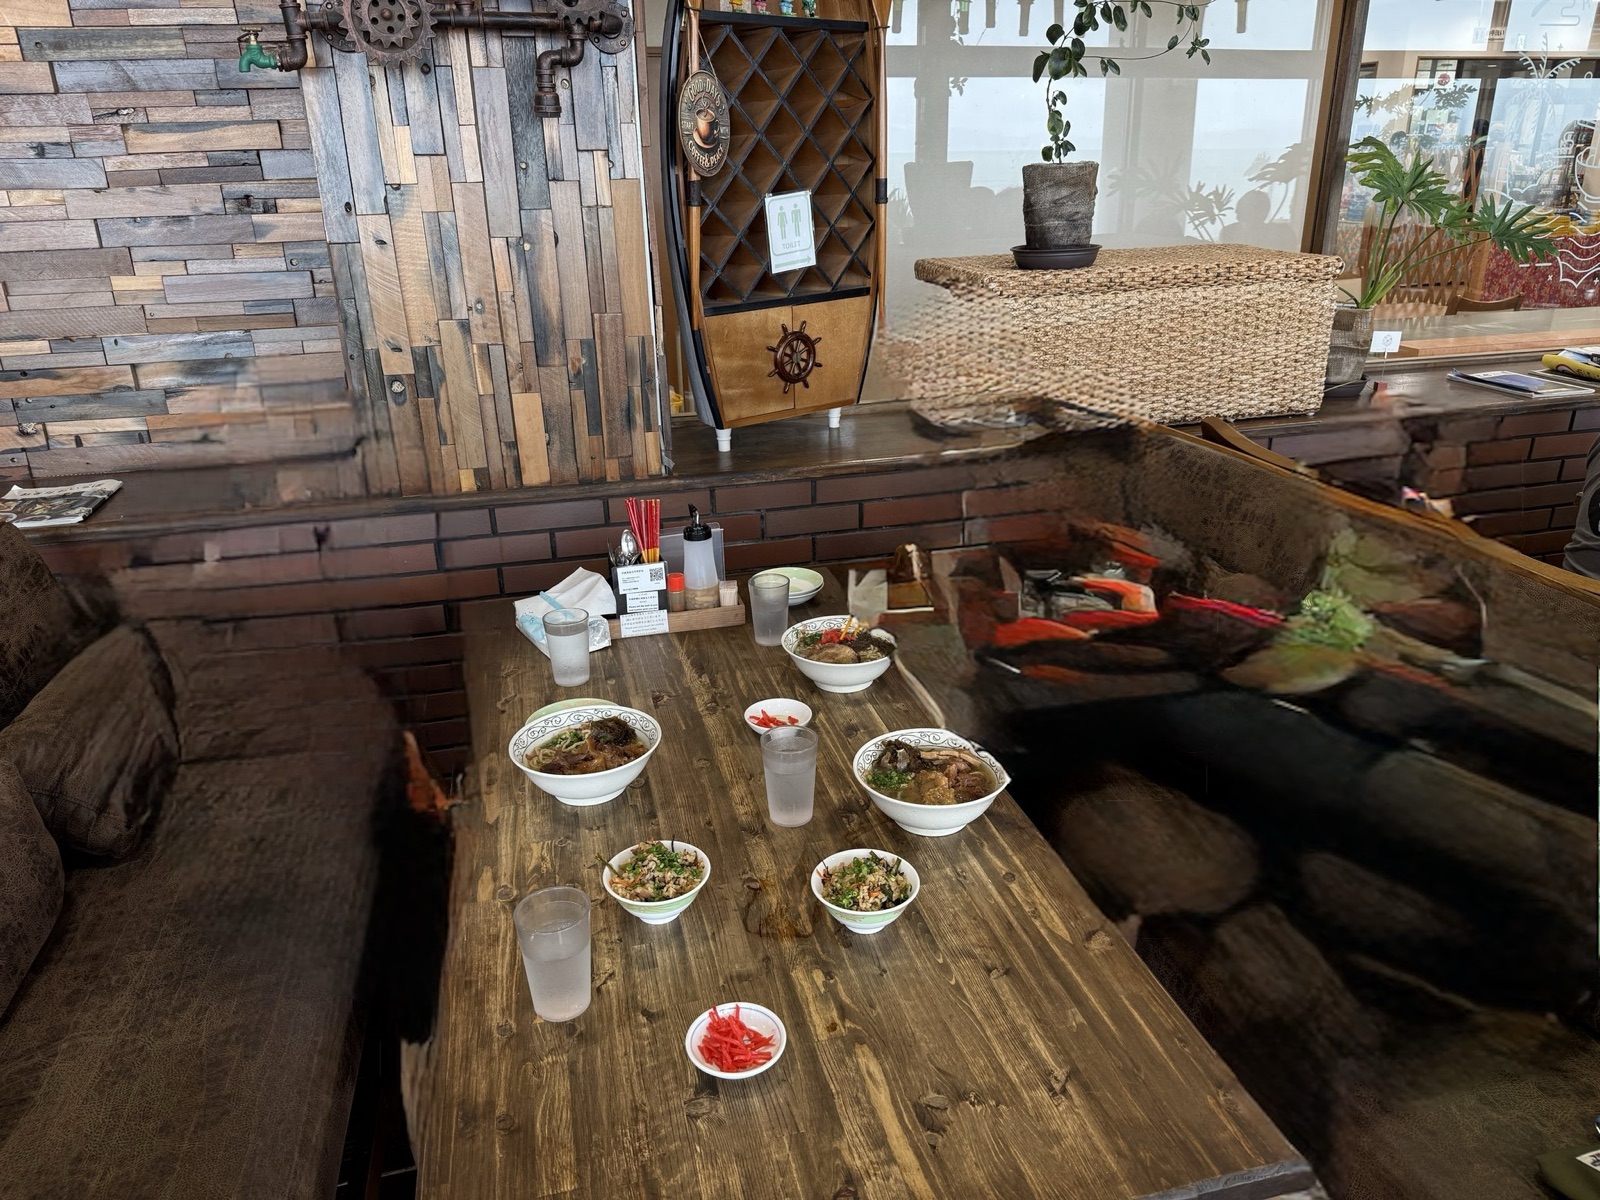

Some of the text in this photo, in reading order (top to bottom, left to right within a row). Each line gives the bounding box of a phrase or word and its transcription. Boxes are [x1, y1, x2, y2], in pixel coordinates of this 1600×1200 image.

[706, 78, 721, 107] DAYS
[681, 121, 694, 130] START
[710, 143, 724, 167] PEACE
[782, 240, 801, 250] TOILET
